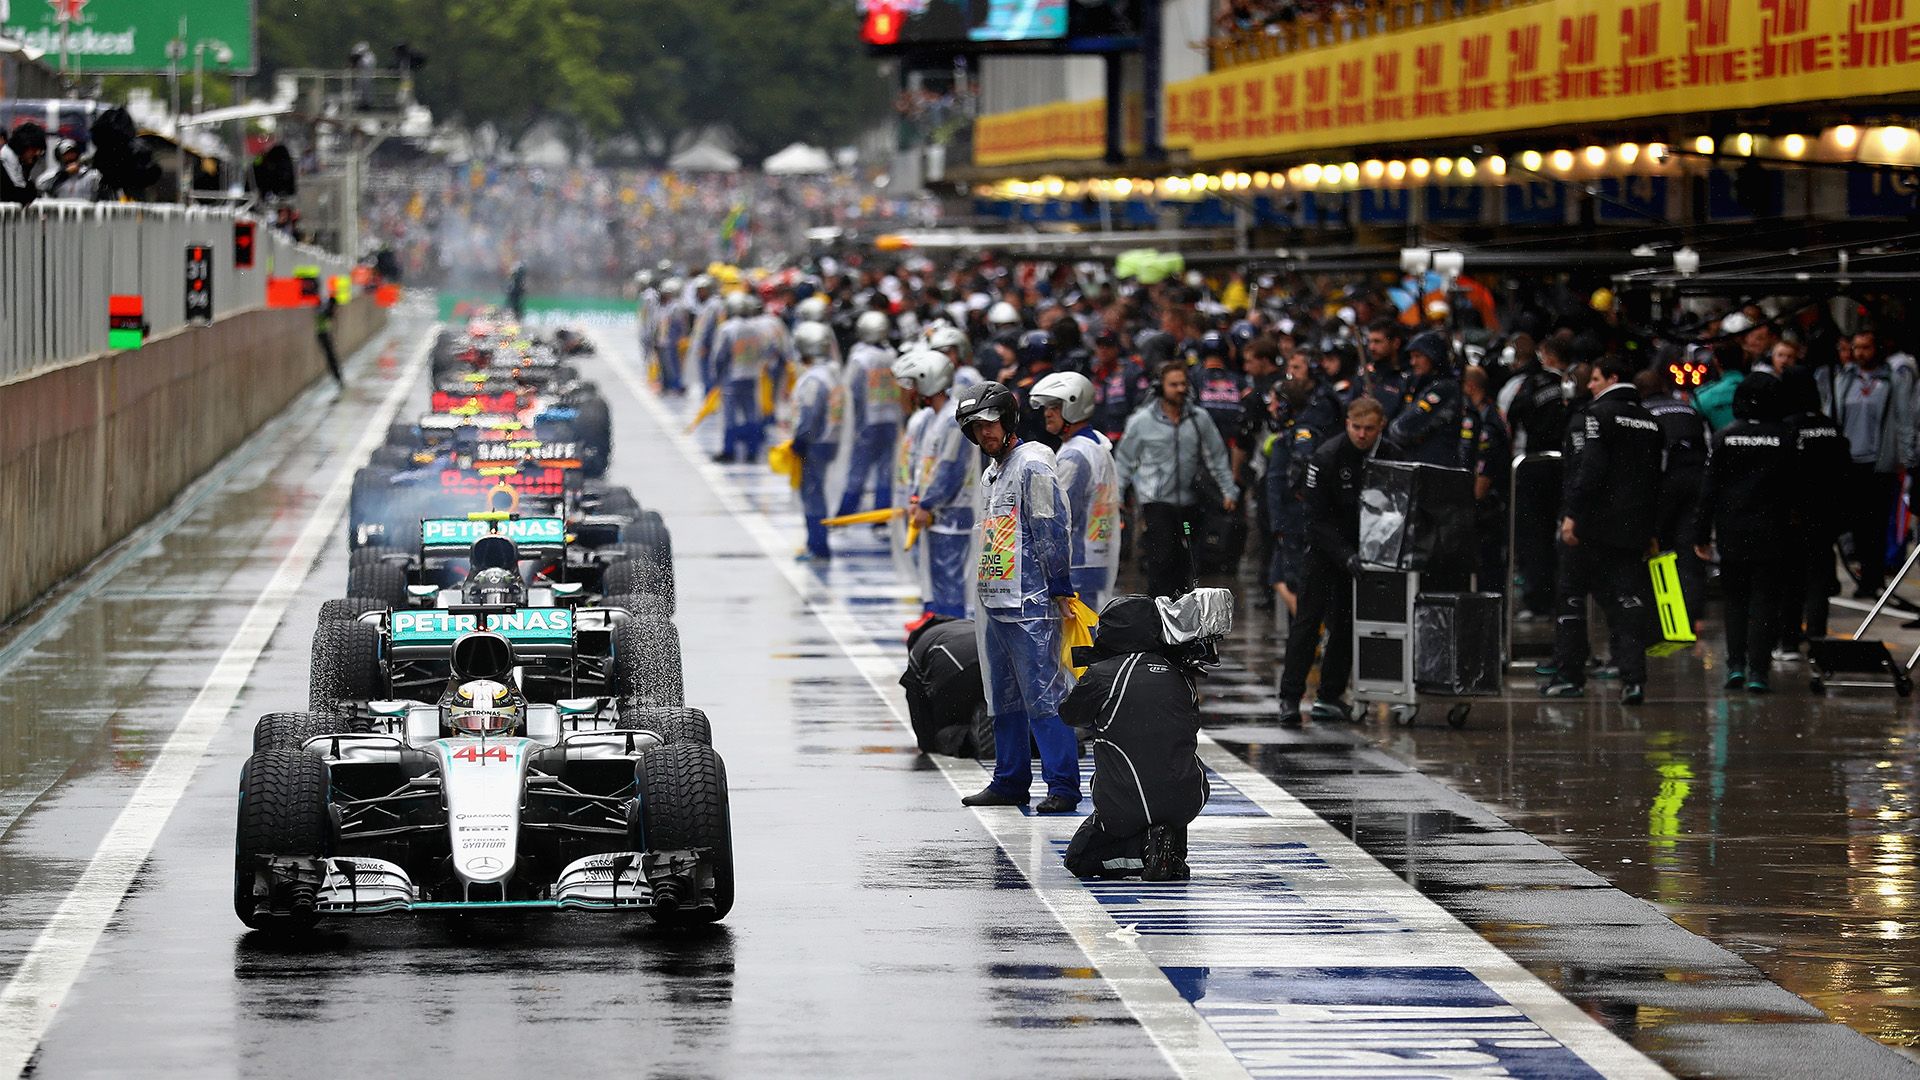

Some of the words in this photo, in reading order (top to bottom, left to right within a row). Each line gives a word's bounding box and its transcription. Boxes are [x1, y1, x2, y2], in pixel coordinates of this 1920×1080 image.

[1724, 436, 1781, 447] PETRONAS
[426, 520, 562, 538] PETRONAS
[481, 587, 510, 595] PETRONAS
[395, 612, 569, 633] PETRONAS
[453, 745, 514, 762] 44
